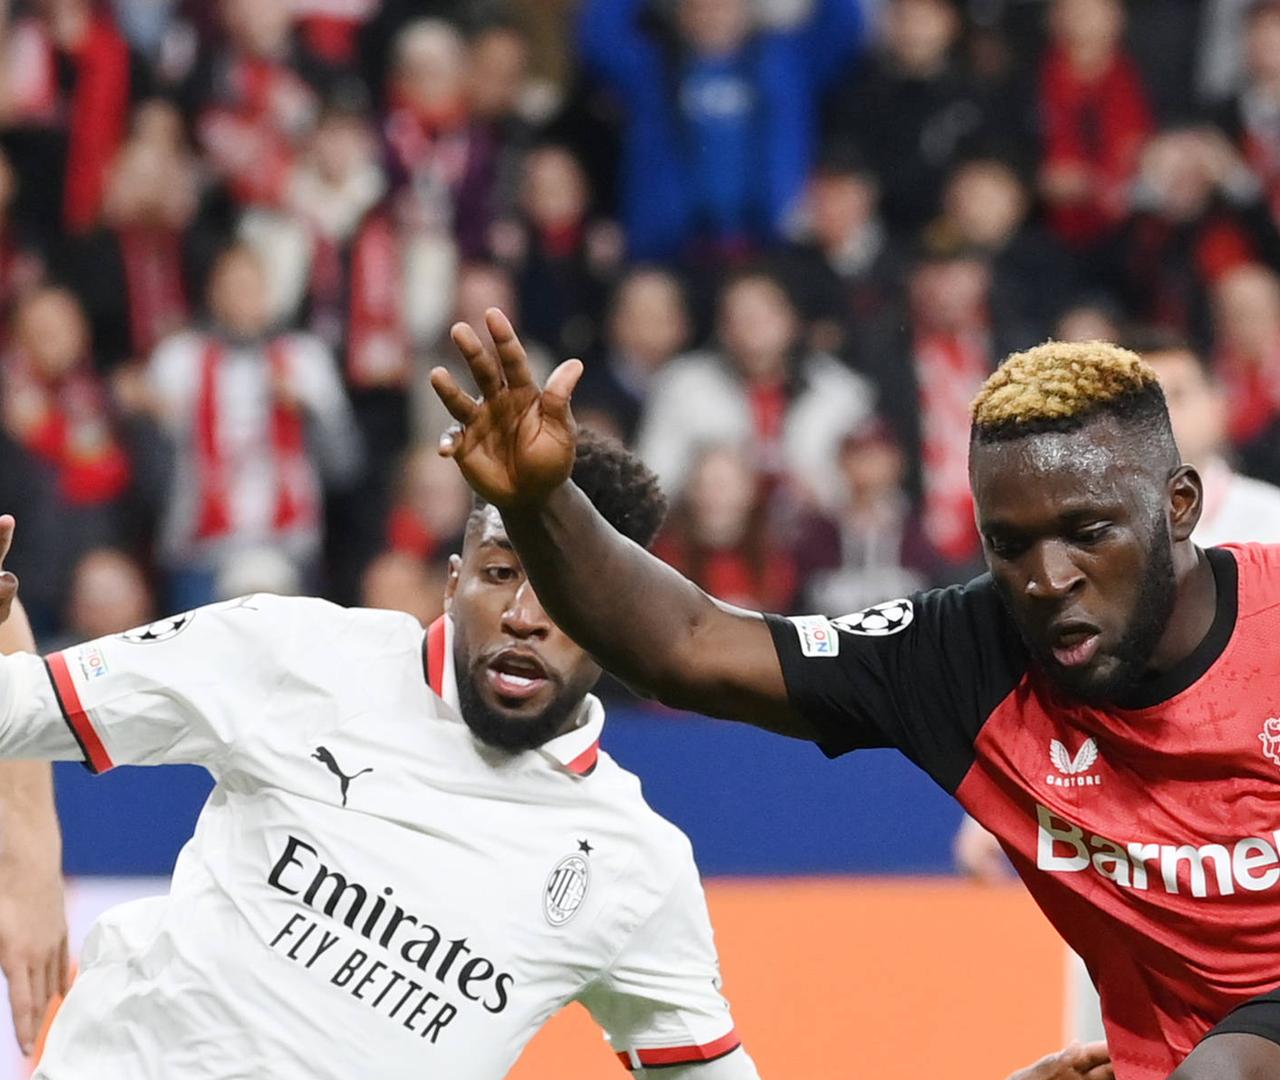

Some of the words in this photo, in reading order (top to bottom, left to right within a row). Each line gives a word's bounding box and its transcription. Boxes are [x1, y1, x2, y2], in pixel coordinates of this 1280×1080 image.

[1046, 774, 1101, 788] CASTORE
[267, 836, 515, 1014] Emirates
[270, 913, 339, 968] FLY
[330, 948, 458, 1045] BETTER
